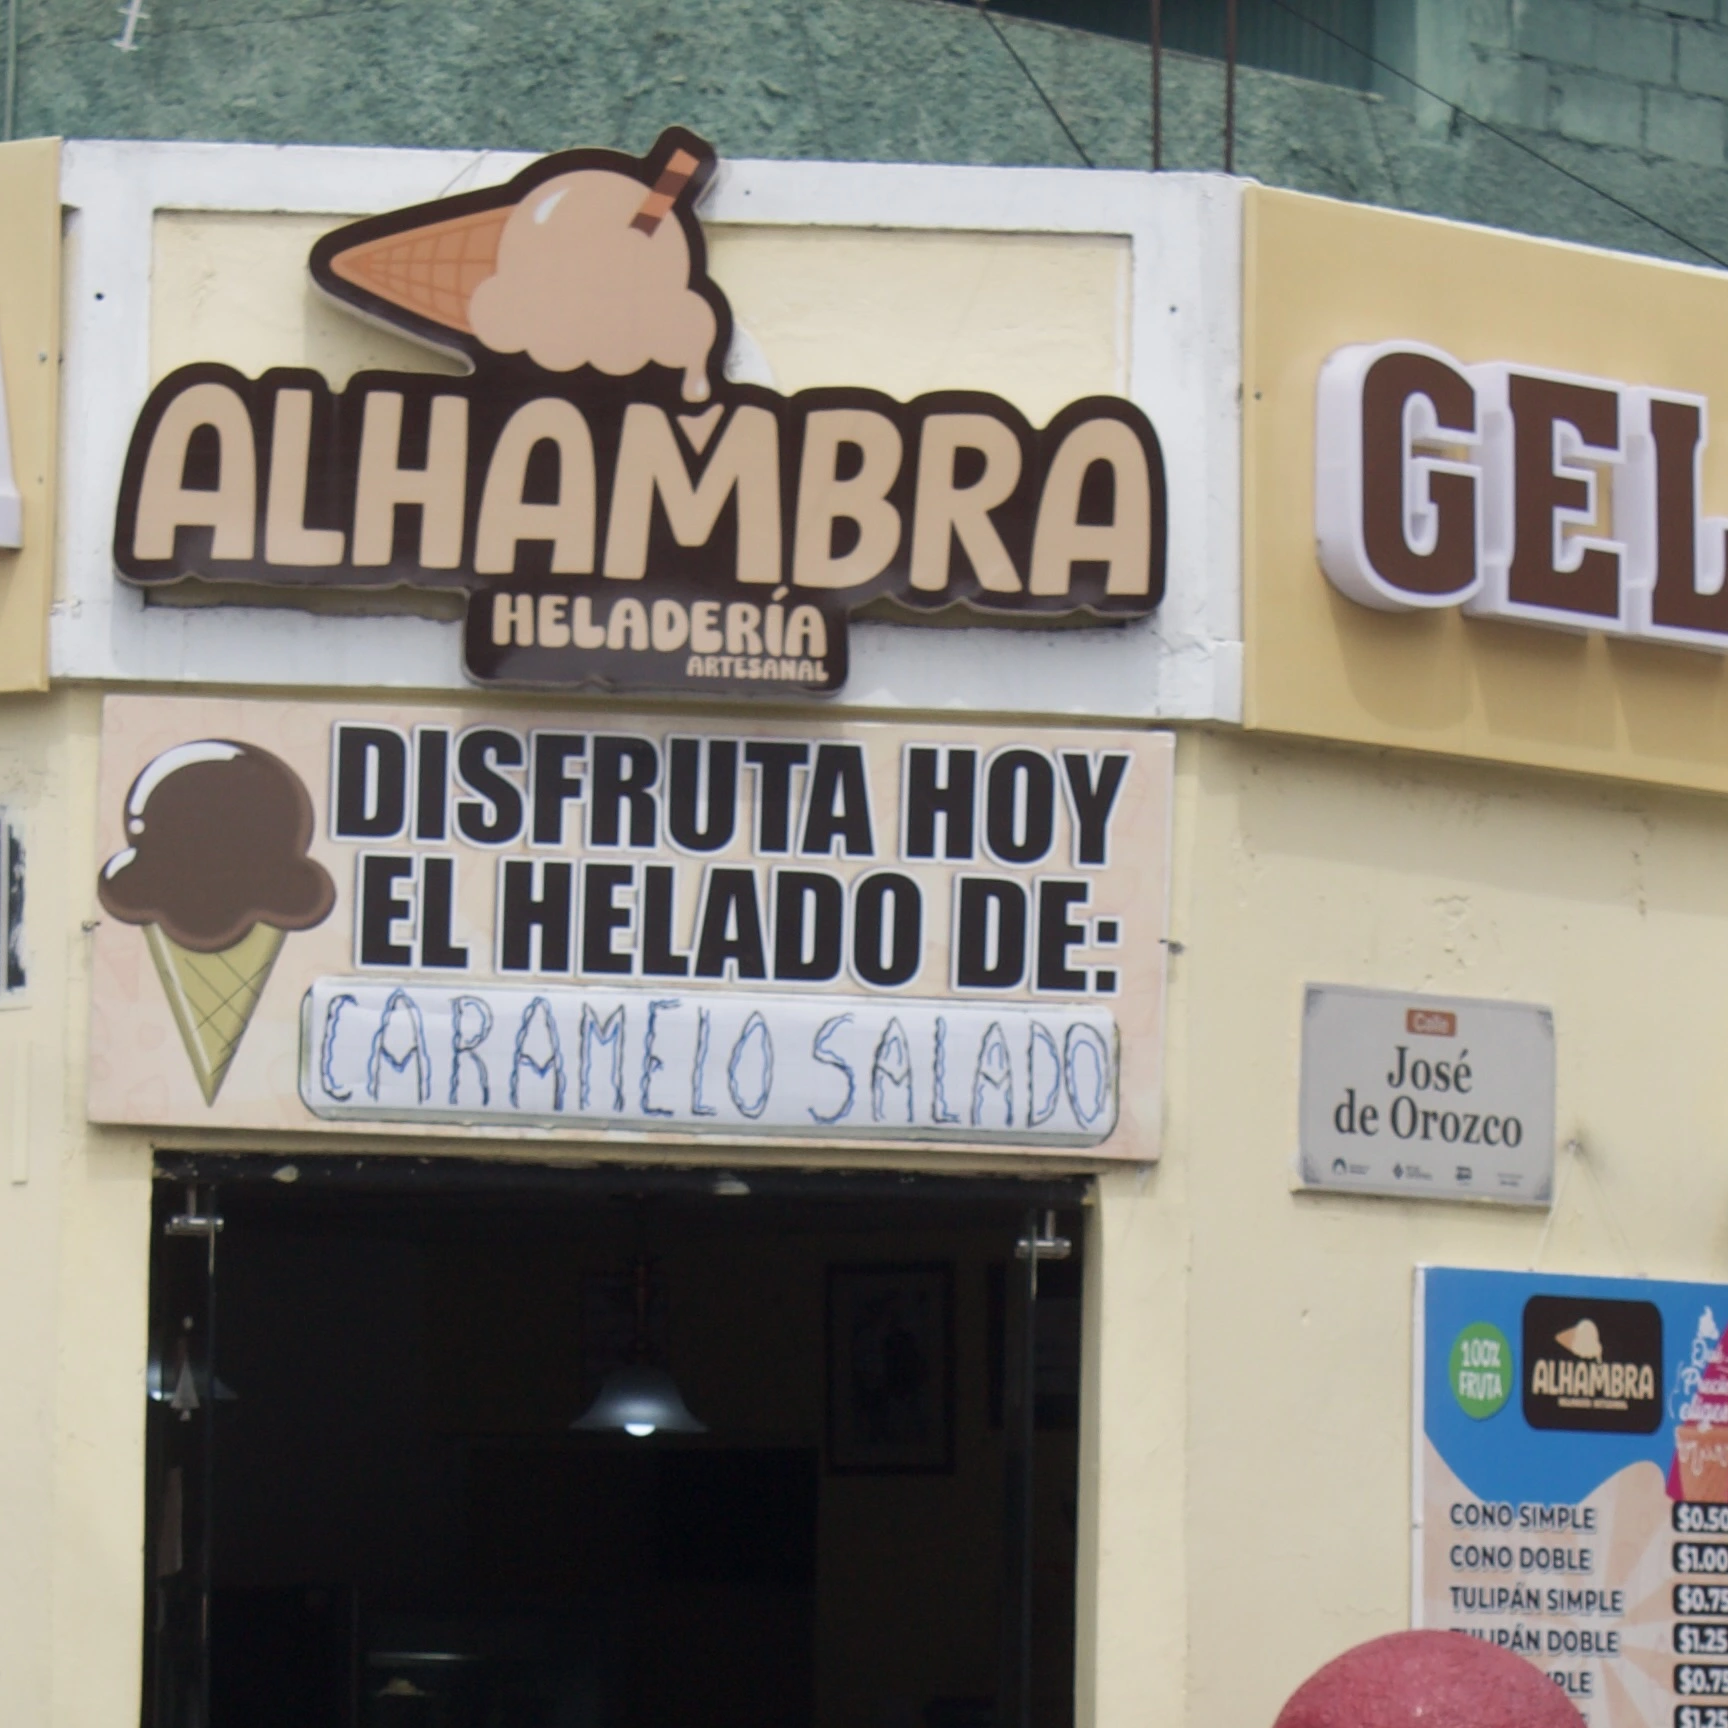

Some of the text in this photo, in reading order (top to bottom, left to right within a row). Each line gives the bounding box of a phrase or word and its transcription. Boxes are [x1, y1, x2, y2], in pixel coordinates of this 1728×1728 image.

[132, 383, 1151, 597] ALHAMBRA
[492, 585, 828, 658] HELADERÍA
[685, 654, 828, 683] ARTESANAL
[332, 724, 1129, 865] DISFRUTA HOY
[359, 853, 1119, 992] EL HELADO DE:
[320, 987, 1110, 1129] CARAMELO SALADO
[1387, 1046, 1473, 1094] José
[1334, 1088, 1522, 1148] de Orozco
[1461, 1338, 1501, 1369] 100%
[1459, 1370, 1503, 1400] FRUTA
[1532, 1359, 1655, 1400] ALHAMBRA
[1450, 1503, 1595, 1530] CONO SIMPLE
[1450, 1545, 1591, 1570] CONO DOBLE
[1450, 1582, 1622, 1611] TULIPÁN SIMPLE
[1450, 1624, 1619, 1653] IPÁN DOBLE
[1678, 1625, 1728, 1654] $1.25
